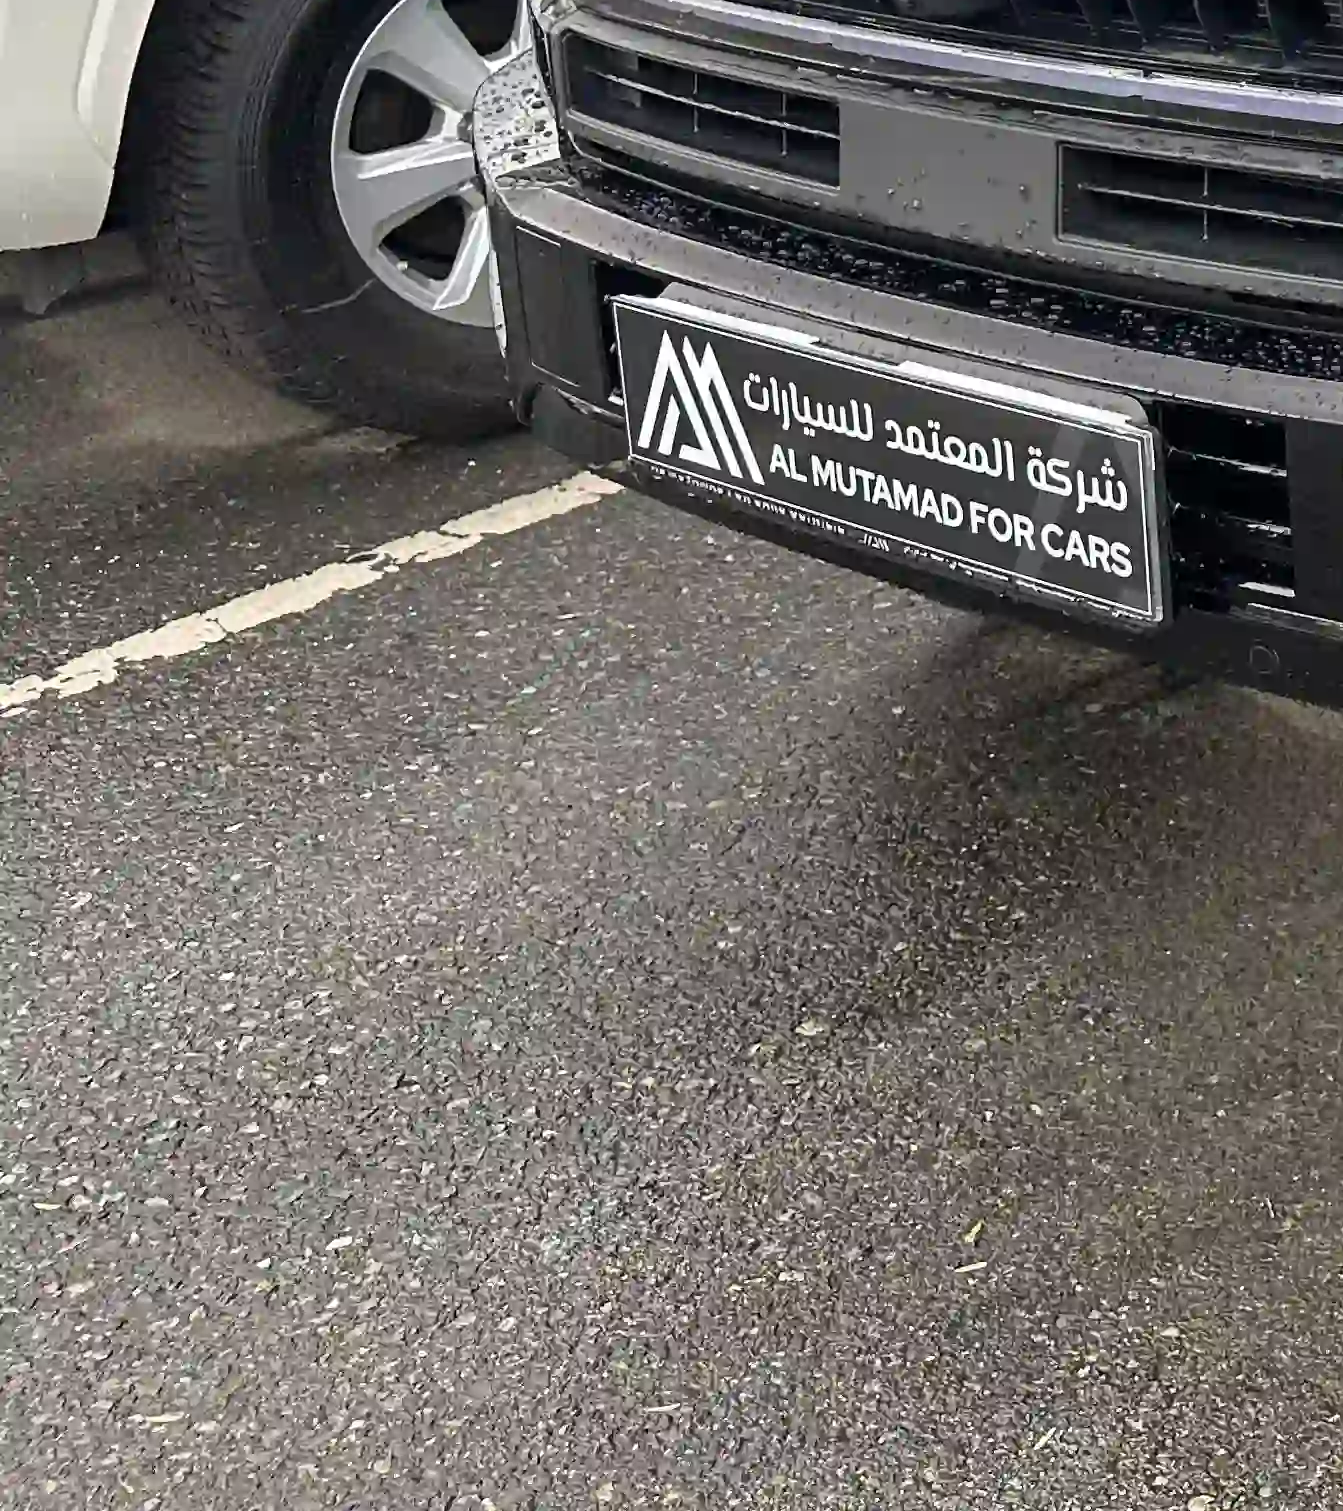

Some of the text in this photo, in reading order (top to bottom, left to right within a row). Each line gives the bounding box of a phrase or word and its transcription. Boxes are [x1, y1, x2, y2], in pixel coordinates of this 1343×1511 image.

[743, 372, 1128, 514] شركة المعتمد للسيارات
[769, 443, 808, 483] AL
[811, 454, 964, 528] MUTAMAD
[968, 499, 1036, 551] FOR
[1040, 523, 1133, 578] CARS
